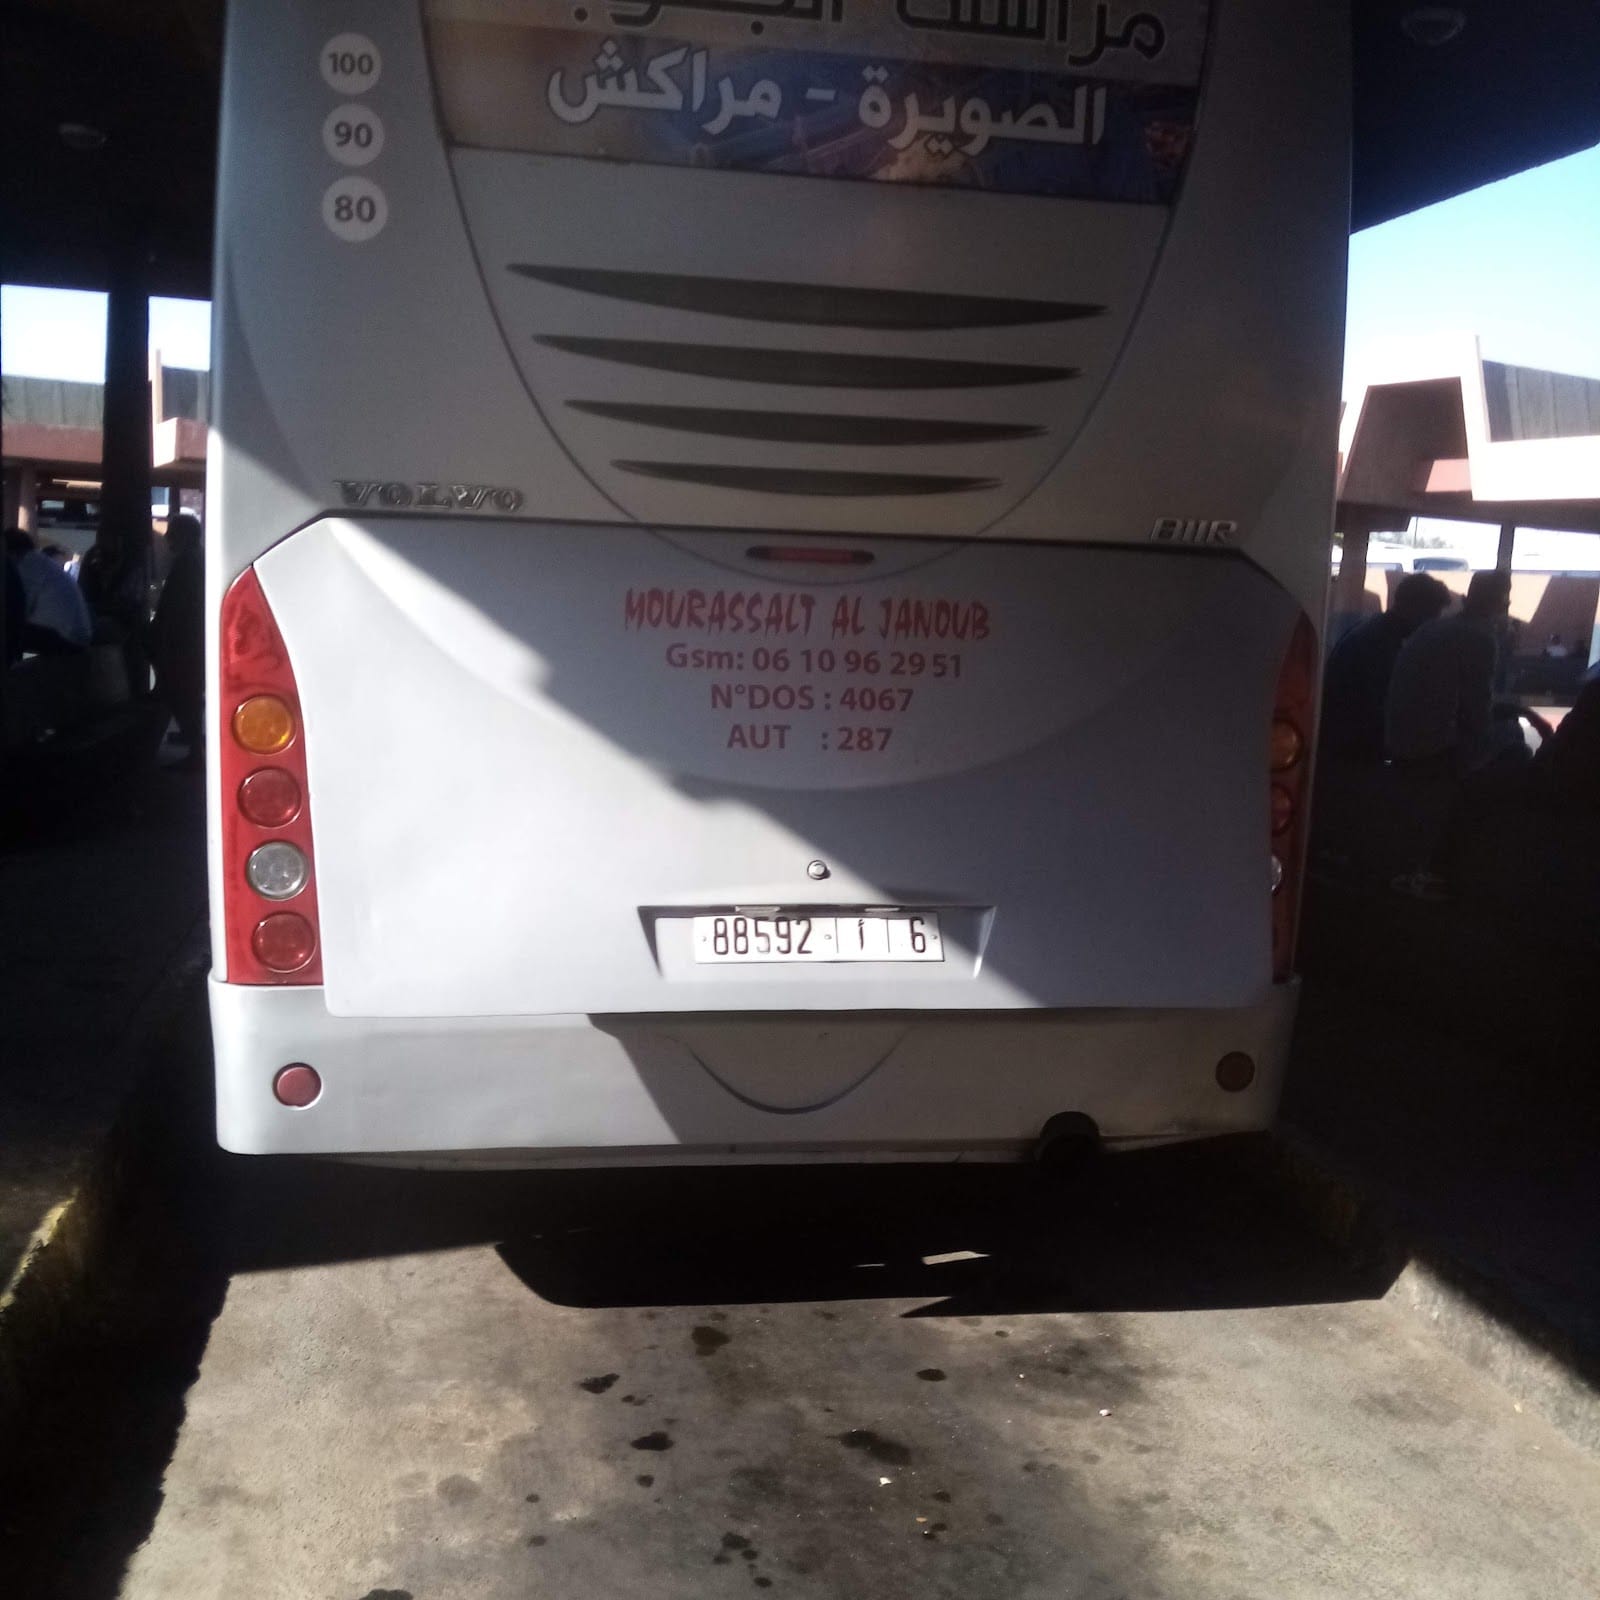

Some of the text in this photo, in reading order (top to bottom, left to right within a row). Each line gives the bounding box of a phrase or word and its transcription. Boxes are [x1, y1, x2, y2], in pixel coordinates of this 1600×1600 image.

[328, 52, 374, 76] 100
[548, 39, 782, 136] مراكش
[858, 65, 1107, 157] الصويرة
[333, 121, 373, 148] 90
[334, 194, 376, 223] 80
[333, 480, 523, 512] VOLVO
[624, 588, 991, 641] MOURASSALT AL JANOUB
[665, 643, 962, 679] Gsm: 06 10 96 29 51
[711, 683, 815, 710] N°DOS
[840, 687, 914, 712] 4067
[727, 724, 791, 749] AUT
[837, 727, 893, 752] 287
[713, 917, 812, 955] 88592
[909, 916, 926, 954] 6
